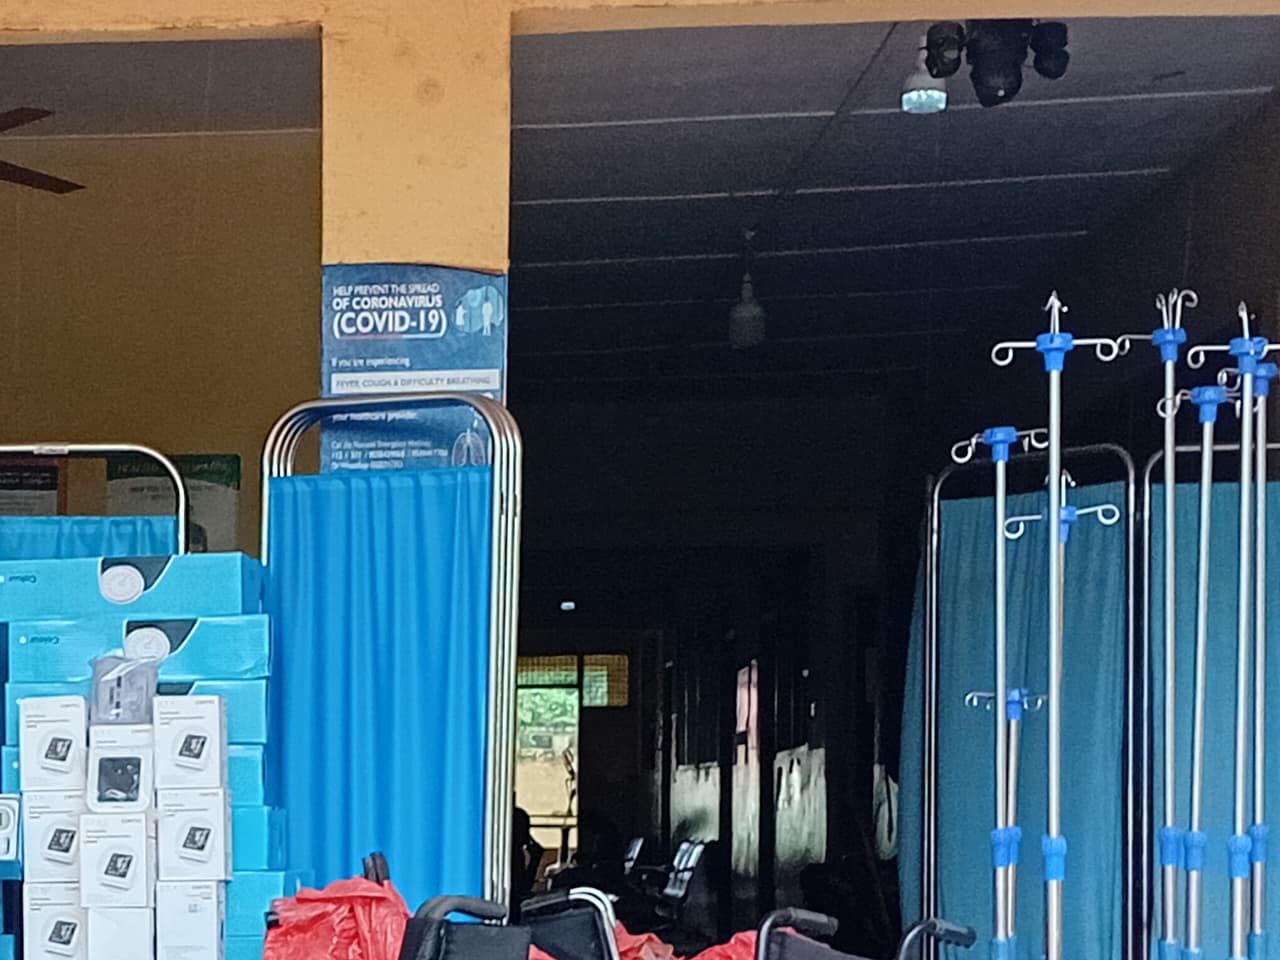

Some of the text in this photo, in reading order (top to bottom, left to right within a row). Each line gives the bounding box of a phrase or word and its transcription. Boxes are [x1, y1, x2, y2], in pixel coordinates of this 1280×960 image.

[332, 282, 440, 297] HELP PREVENT THE SPREAD
[331, 294, 443, 311] OF CORONAVIRUS
[333, 309, 447, 339] (COVID-19)
